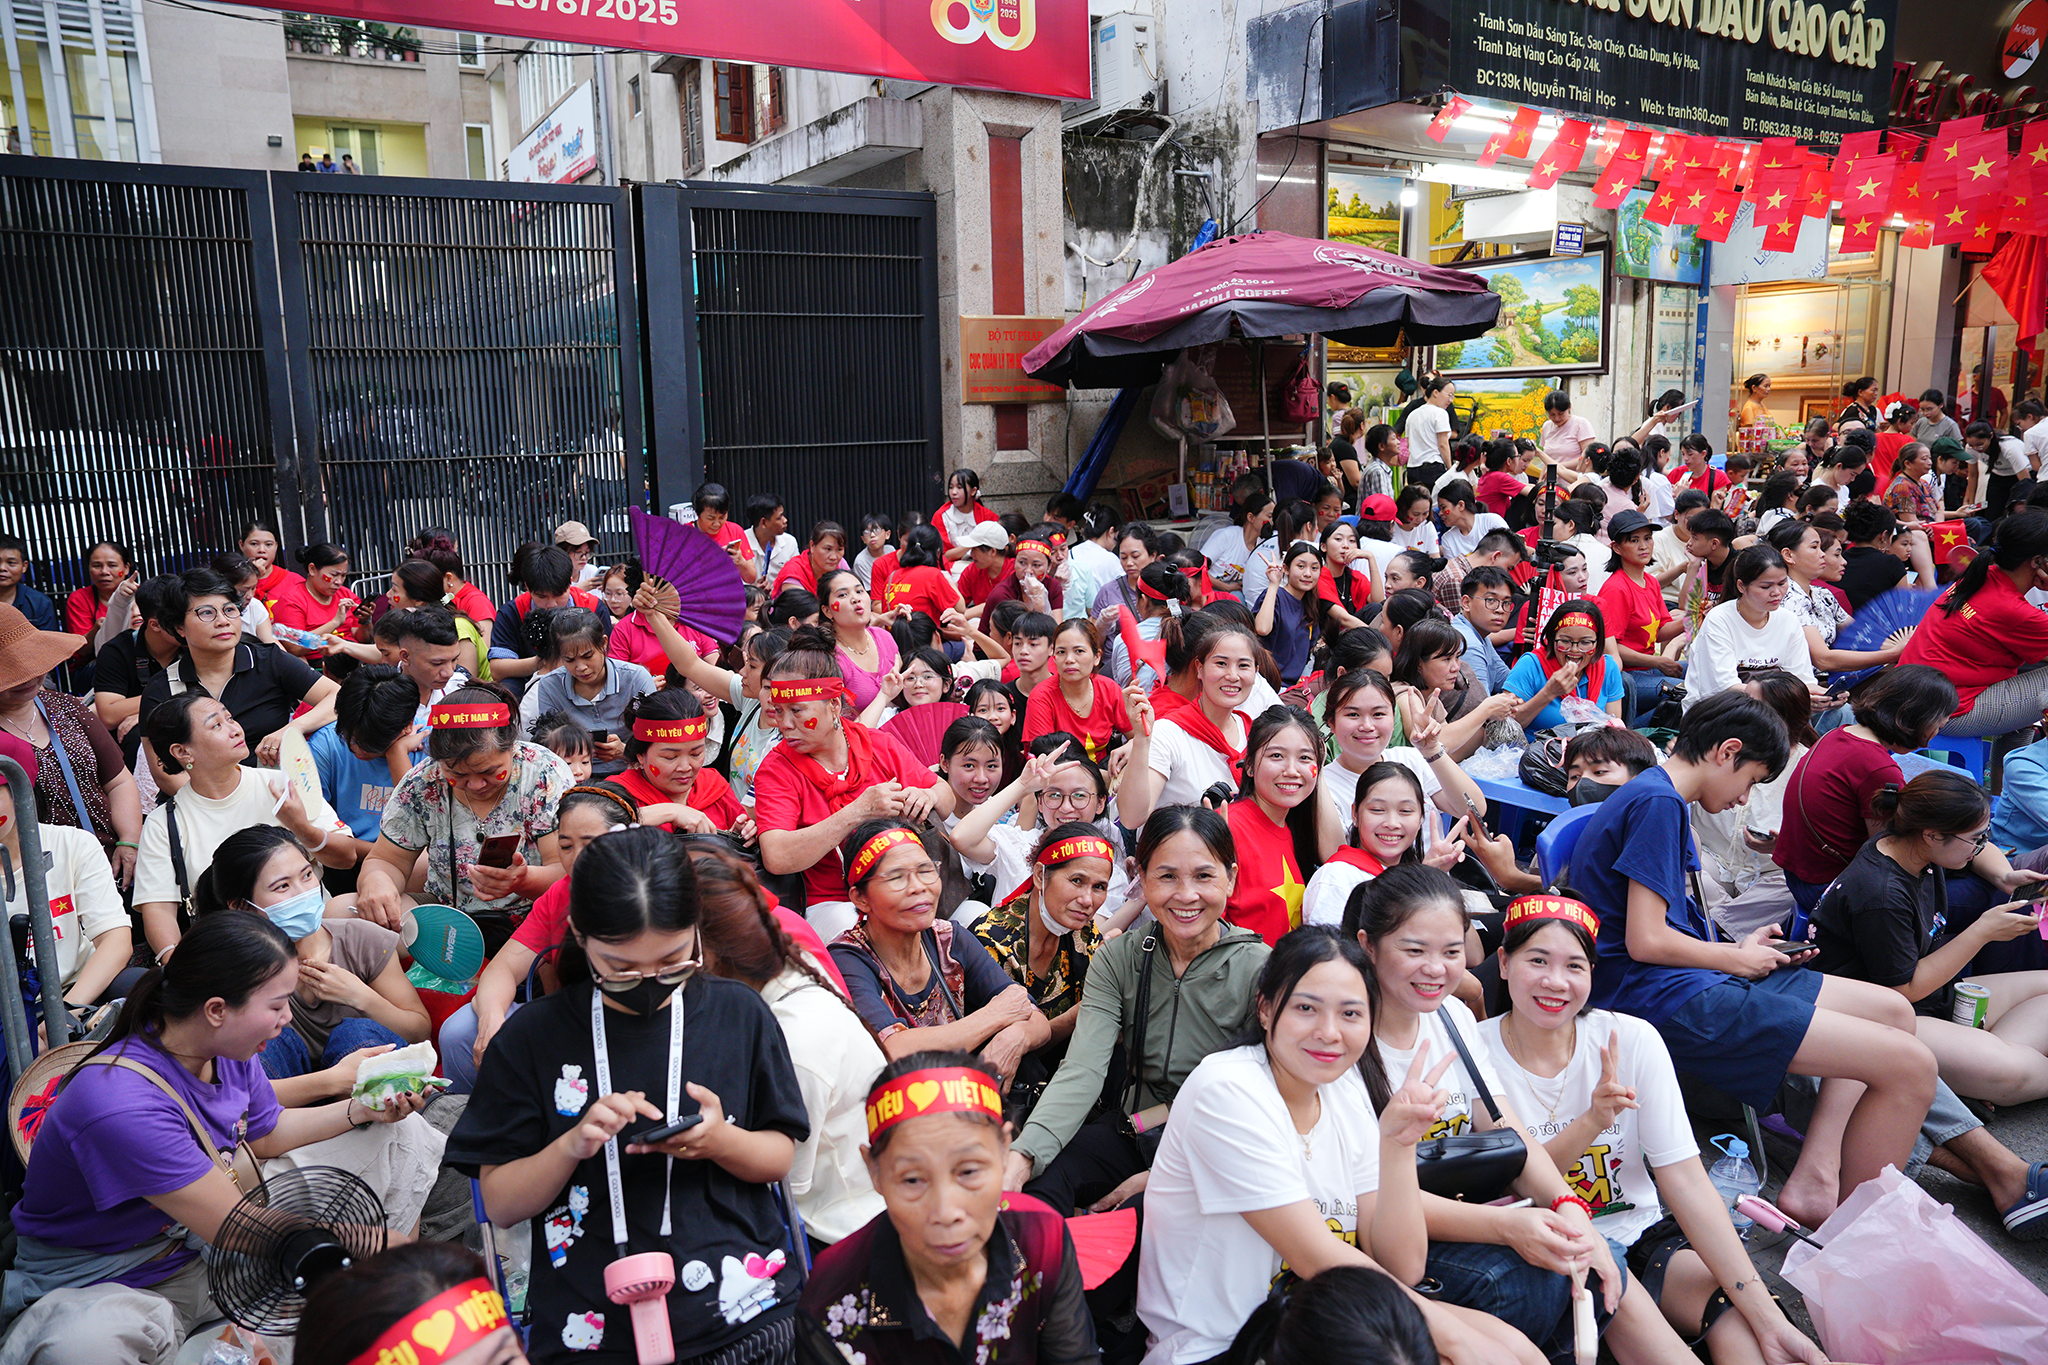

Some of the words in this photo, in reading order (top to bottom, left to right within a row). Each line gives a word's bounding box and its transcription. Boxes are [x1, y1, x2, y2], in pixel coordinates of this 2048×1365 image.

[1000, 8, 1017, 19] 2025
[1768, 0, 1827, 58] CAO
[1479, 12, 1505, 32] Tranh
[1507, 18, 1524, 36] Sơn
[1526, 19, 1544, 41] Dầu
[1546, 26, 1567, 47] Sáng
[1569, 30, 1585, 49] Tác,
[1587, 35, 1603, 51] Sao
[1604, 38, 1626, 58] Chép,
[1628, 43, 1648, 60] Chân
[1650, 48, 1671, 67] Dung,
[1673, 51, 1683, 70] Ký
[1684, 54, 1701, 71] Họa.
[1505, 40, 1521, 59] Dát
[1523, 45, 1545, 66] Vàng
[1547, 50, 1563, 66] Cao
[1565, 52, 1582, 72] Cấp
[1584, 56, 1601, 73] 24k.
[1746, 68, 1765, 85] Tranh
[1766, 72, 1787, 89] Khách
[1788, 77, 1800, 94] Sạn
[1477, 68, 1521, 91] ĐC139k
[1523, 77, 1566, 100] Nguyễn
[1568, 84, 1592, 103] Thái
[1596, 90, 1617, 110] Học
[1641, 98, 1665, 116] Web:
[1668, 103, 1729, 127] tranh360.com
[1745, 88, 1759, 103] Bán
[1760, 91, 1779, 109] Buôn,
[1780, 95, 1793, 109] Bán
[1804, 100, 1816, 113] Các
[1831, 105, 1848, 119] Tranh
[1743, 117, 1758, 132] ĐT:
[1759, 120, 1813, 141] 0963.28.58.68
[988, 327, 1002, 343] BỘ
[1003, 329, 1017, 341] TƯ
[1018, 327, 1043, 341] PHÁP
[969, 352, 981, 373] CỤC
[780, 688, 794, 699] VIỆT
[795, 687, 812, 696] NAM
[453, 713, 470, 724] VIỆT
[471, 713, 489, 722] NAM
[656, 728, 667, 737] TÔI
[668, 728, 682, 737] YÊU
[859, 849, 875, 866] TÔI
[870, 836, 891, 854] YÊU
[1060, 843, 1074, 857] TÔI
[1076, 840, 1094, 853] YÊU
[1510, 903, 1522, 921] TÔI
[1523, 898, 1543, 916] YÊU
[1564, 902, 1583, 920] VIỆT
[876, 1090, 904, 1123] YÊU
[942, 1075, 980, 1108] VIỆT
[1540, 1122, 1560, 1135] TÔI
[1330, 1198, 1345, 1215] LÀ
